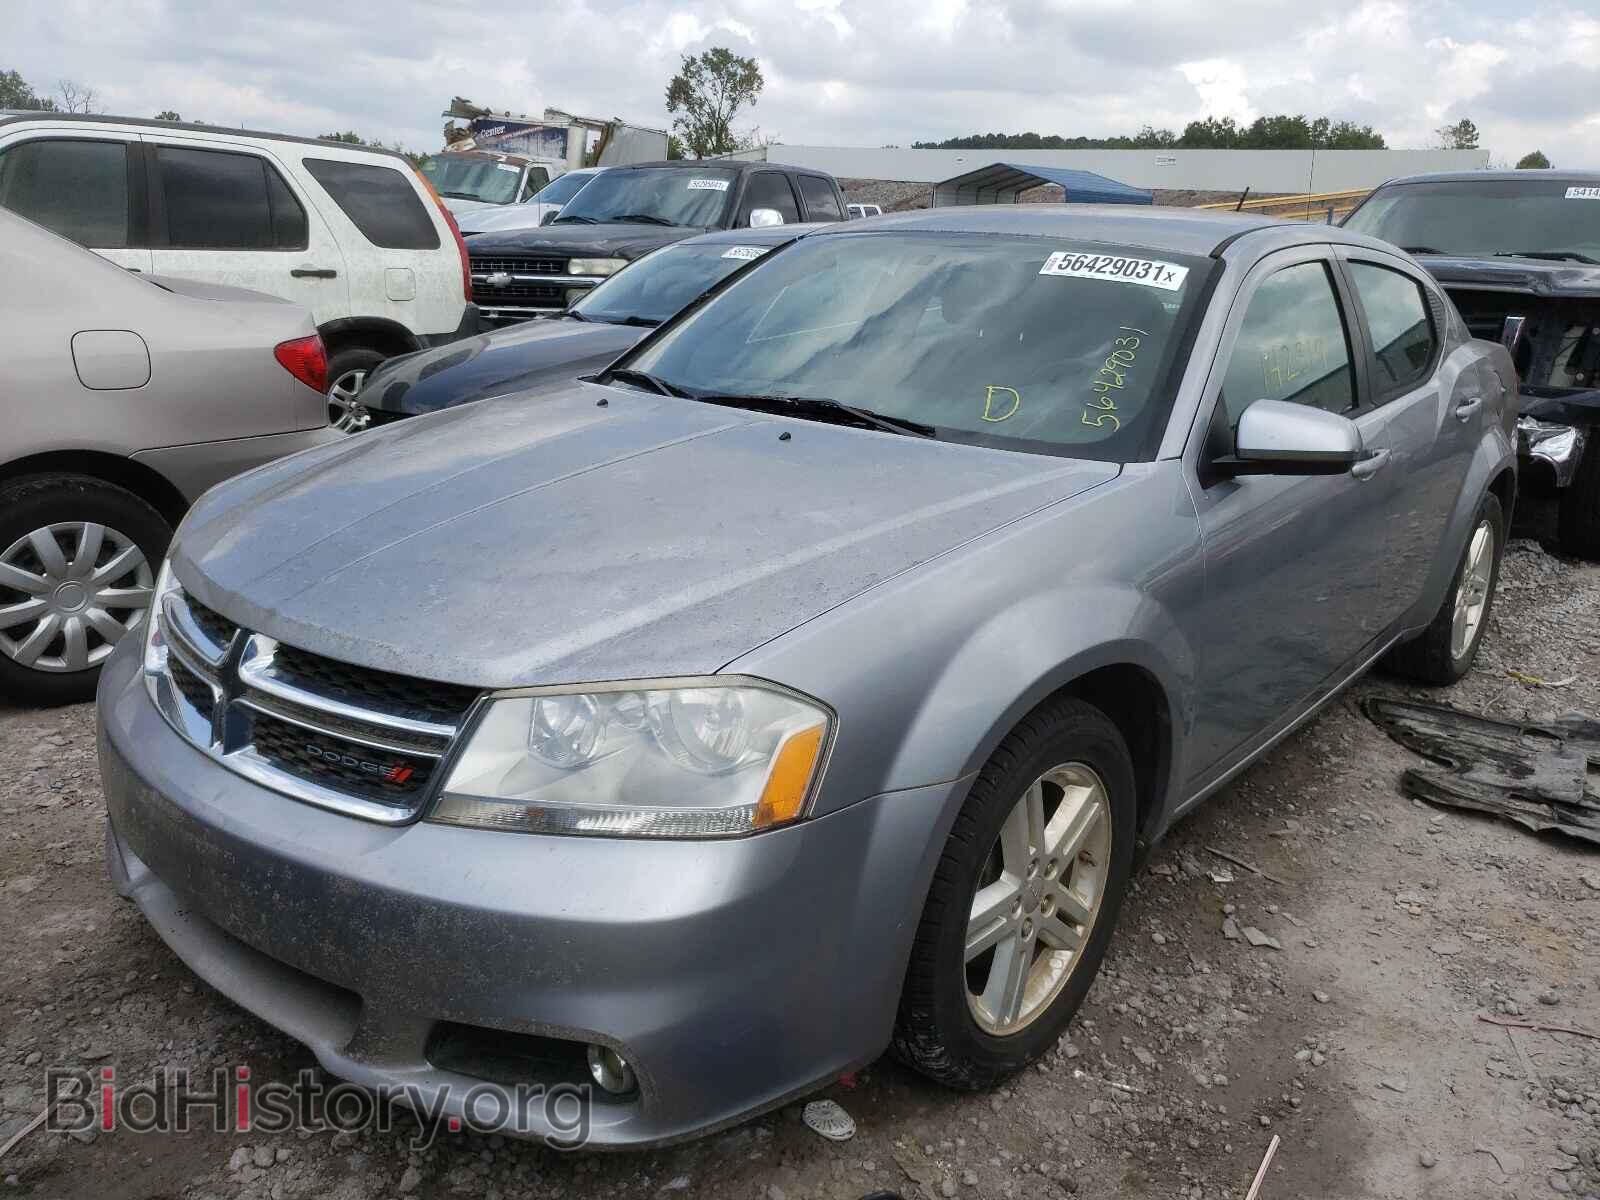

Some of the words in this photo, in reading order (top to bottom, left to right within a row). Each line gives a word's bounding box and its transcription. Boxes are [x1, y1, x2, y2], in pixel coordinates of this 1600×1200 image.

[480, 125, 506, 138] Center
[1573, 187, 1600, 197] 5414
[981, 385, 1020, 422] D
[305, 744, 397, 777] DODGE
